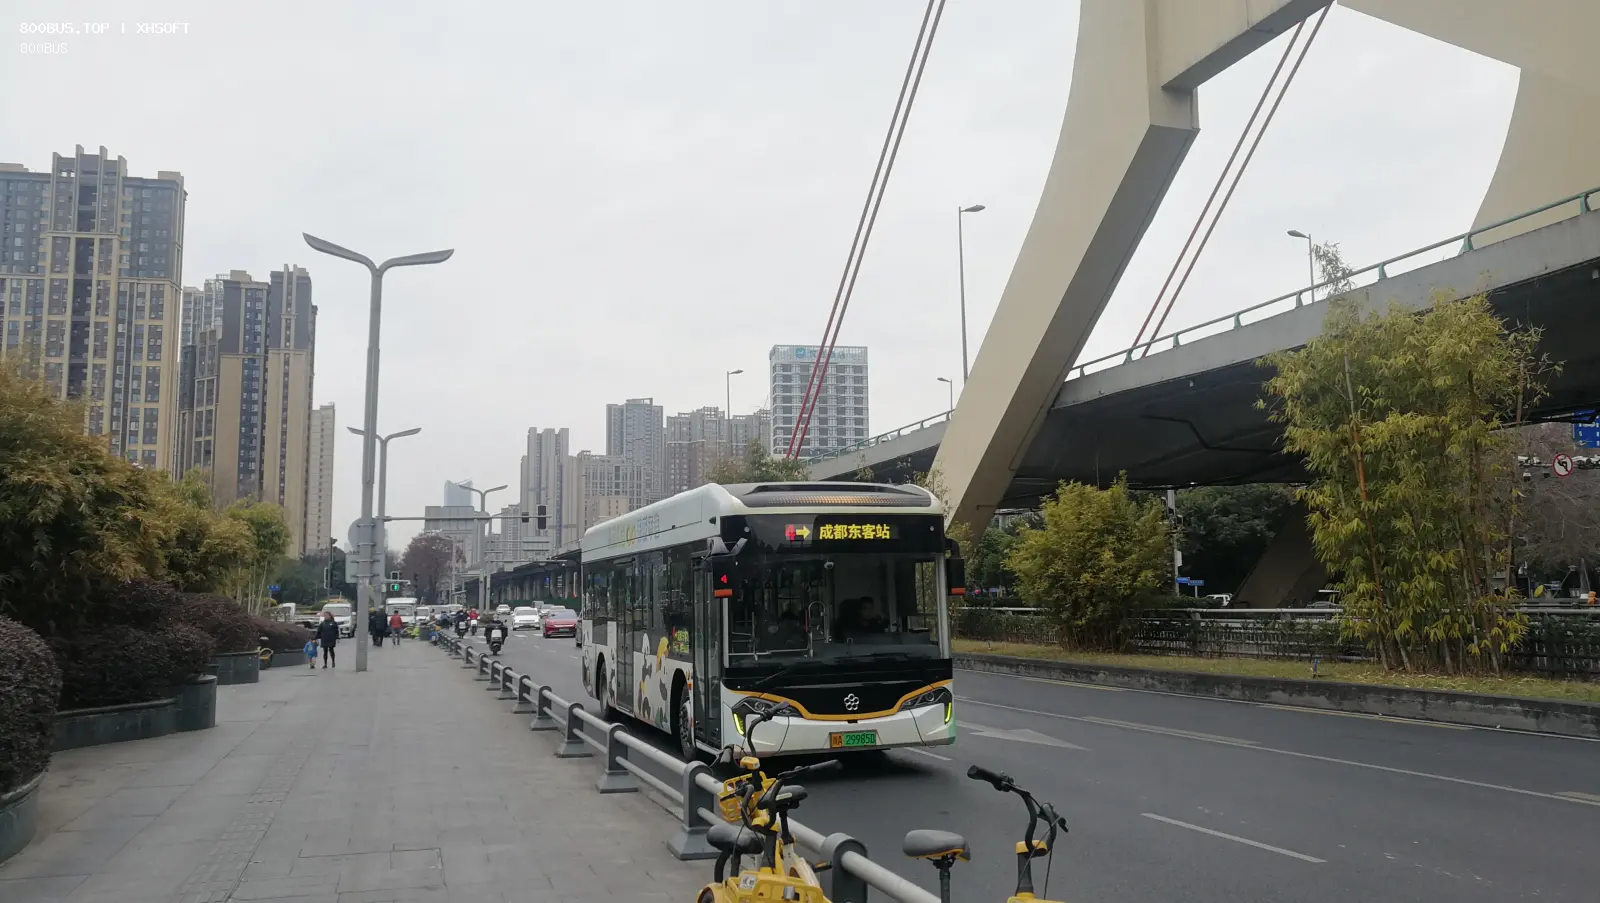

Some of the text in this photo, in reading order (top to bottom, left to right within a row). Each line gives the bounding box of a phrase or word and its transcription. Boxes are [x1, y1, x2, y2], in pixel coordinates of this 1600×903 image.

[785, 523, 890, 540] 4 成都东客站
[720, 574, 728, 584] 4
